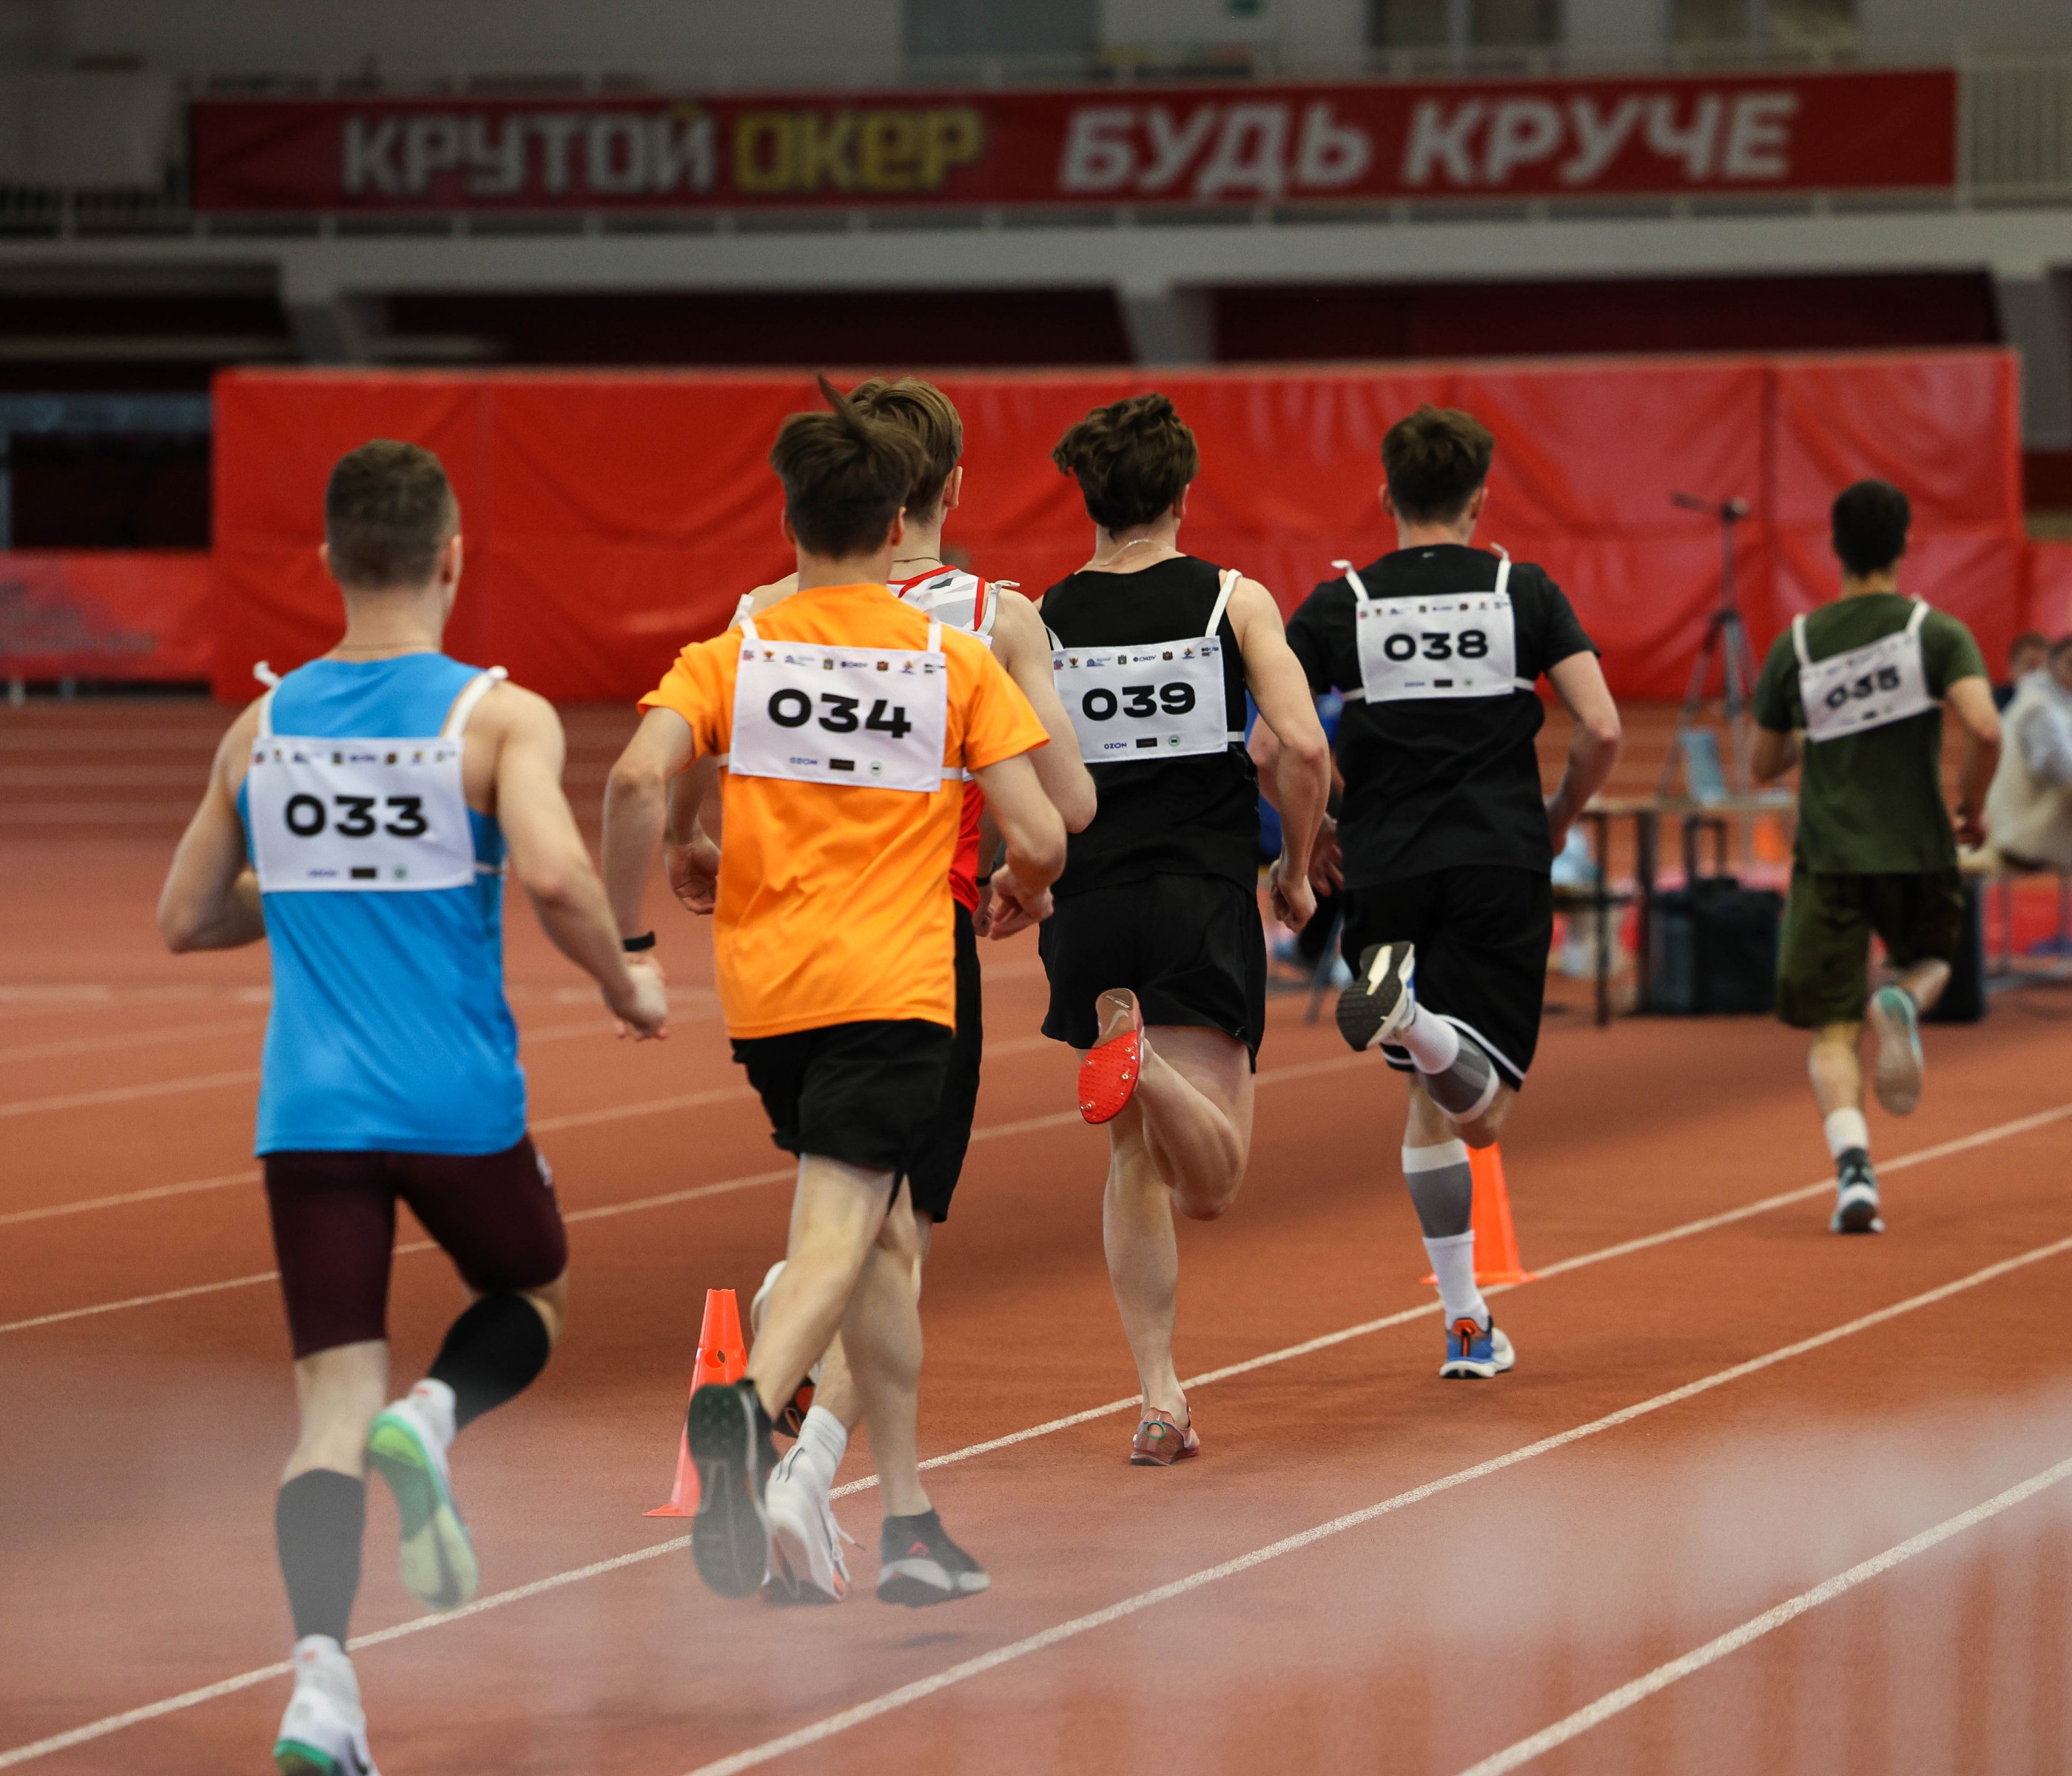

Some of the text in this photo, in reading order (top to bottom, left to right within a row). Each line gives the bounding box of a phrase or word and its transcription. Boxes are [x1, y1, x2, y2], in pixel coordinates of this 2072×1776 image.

[338, 101, 718, 196] КРУТОЙ
[1059, 99, 1373, 201] БУДЬ
[1401, 90, 1801, 186] КРУЧЕ
[1384, 630, 1488, 661] 038
[1082, 682, 1196, 721] 039
[1826, 666, 1900, 708] 035
[768, 688, 912, 739] 034
[285, 793, 427, 837] 033
